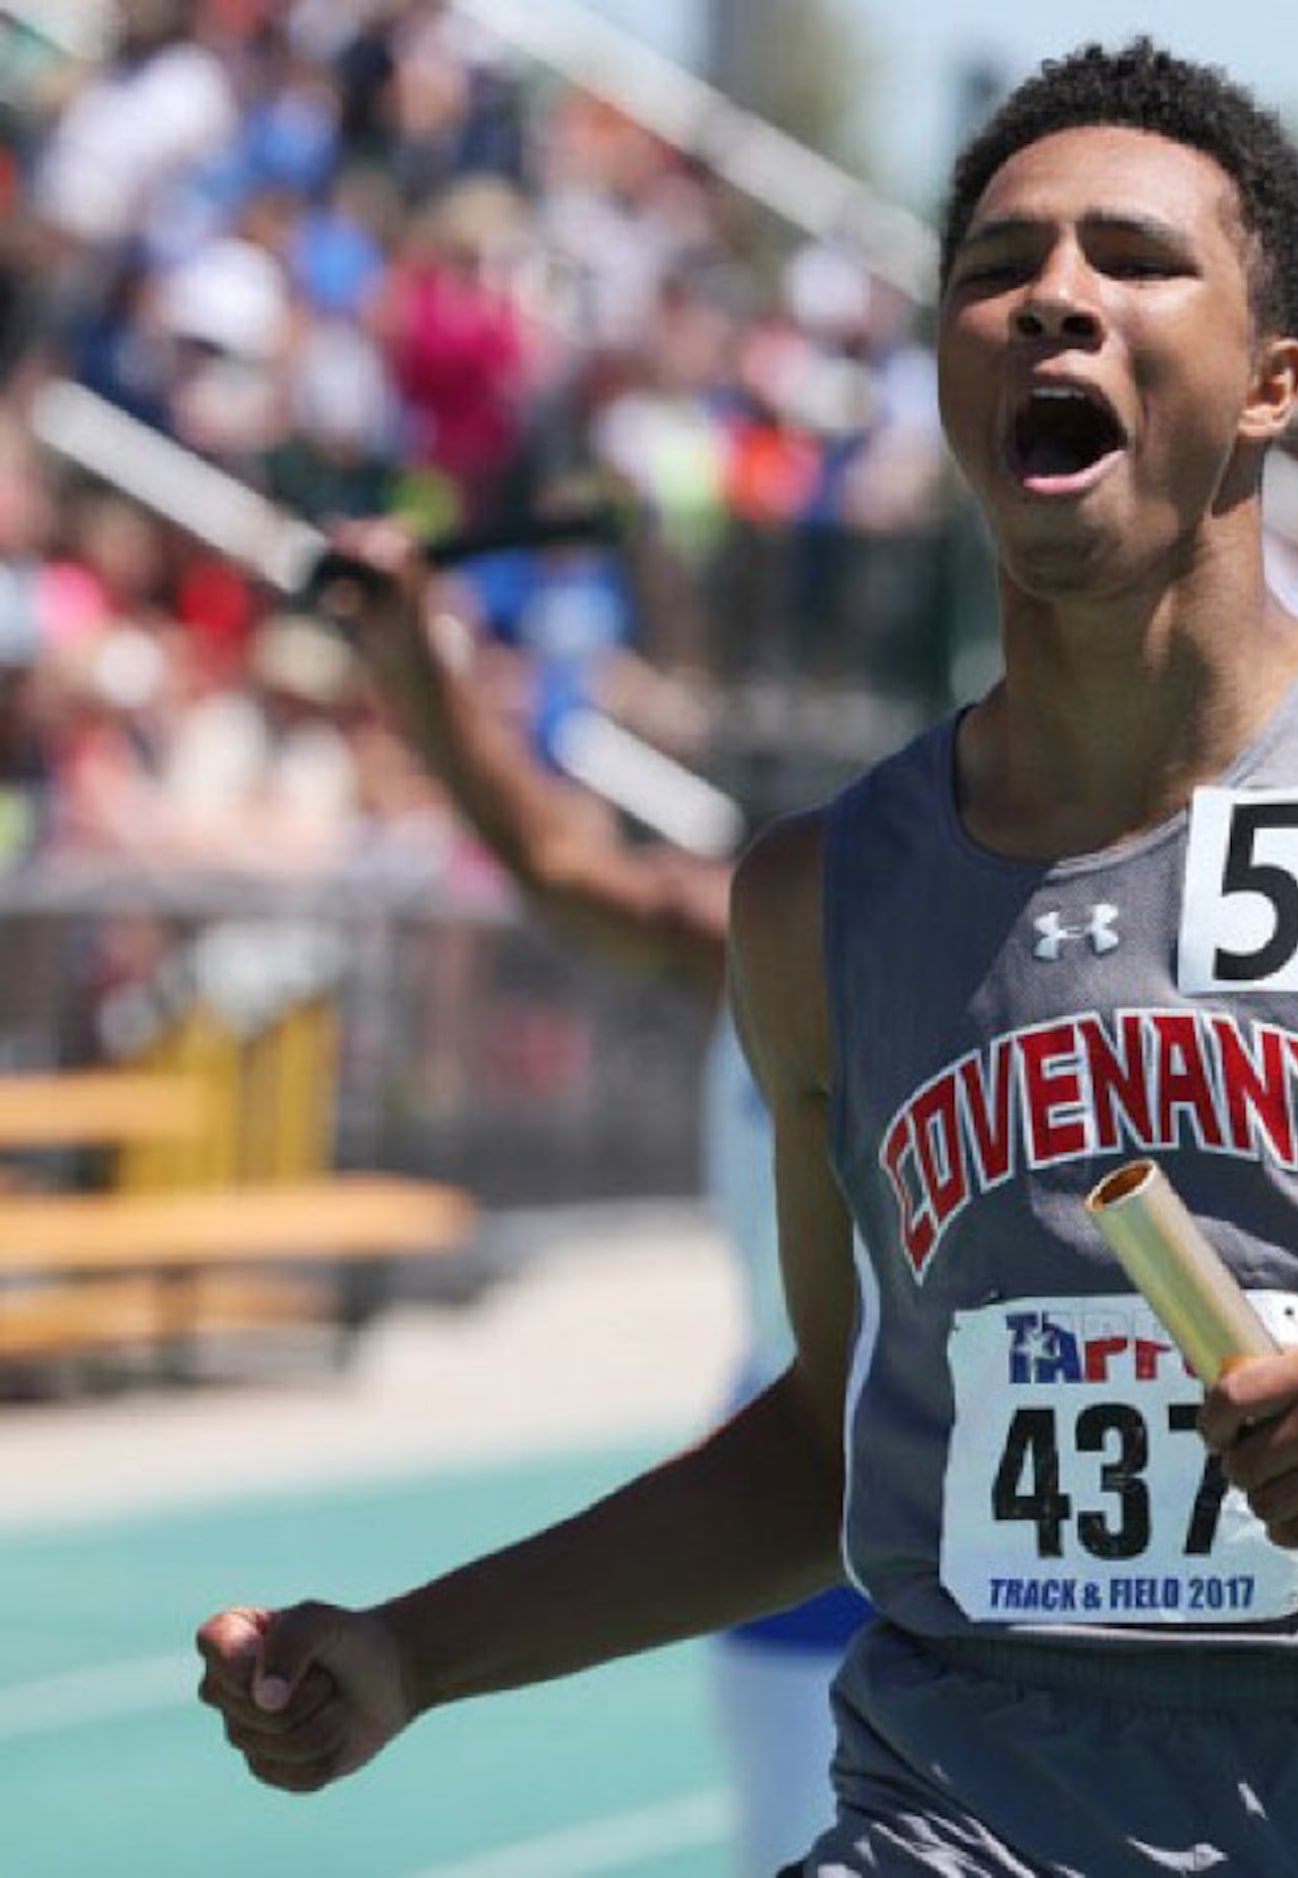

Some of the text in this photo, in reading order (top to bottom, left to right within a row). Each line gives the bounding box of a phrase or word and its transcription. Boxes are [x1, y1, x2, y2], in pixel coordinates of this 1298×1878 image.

[991, 1403, 1230, 1560] 437
[990, 1576, 1255, 1611] TRACK & FIELD 2017
